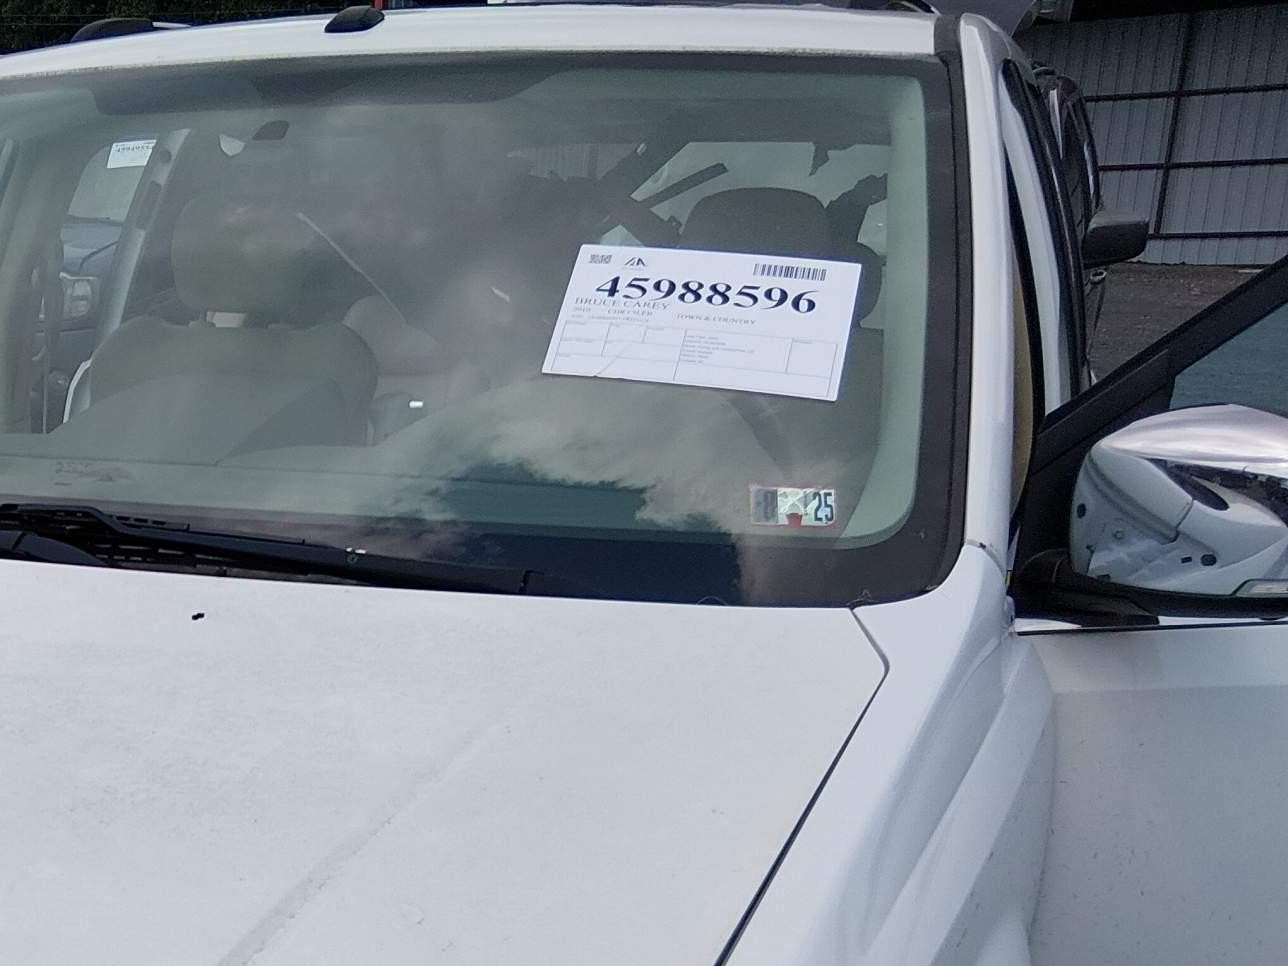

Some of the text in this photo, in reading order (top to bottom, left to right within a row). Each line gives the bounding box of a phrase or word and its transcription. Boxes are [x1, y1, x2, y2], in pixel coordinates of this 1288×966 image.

[595, 275, 820, 314] 45988596
[623, 299, 670, 310] CAREY
[812, 491, 834, 522] 25
